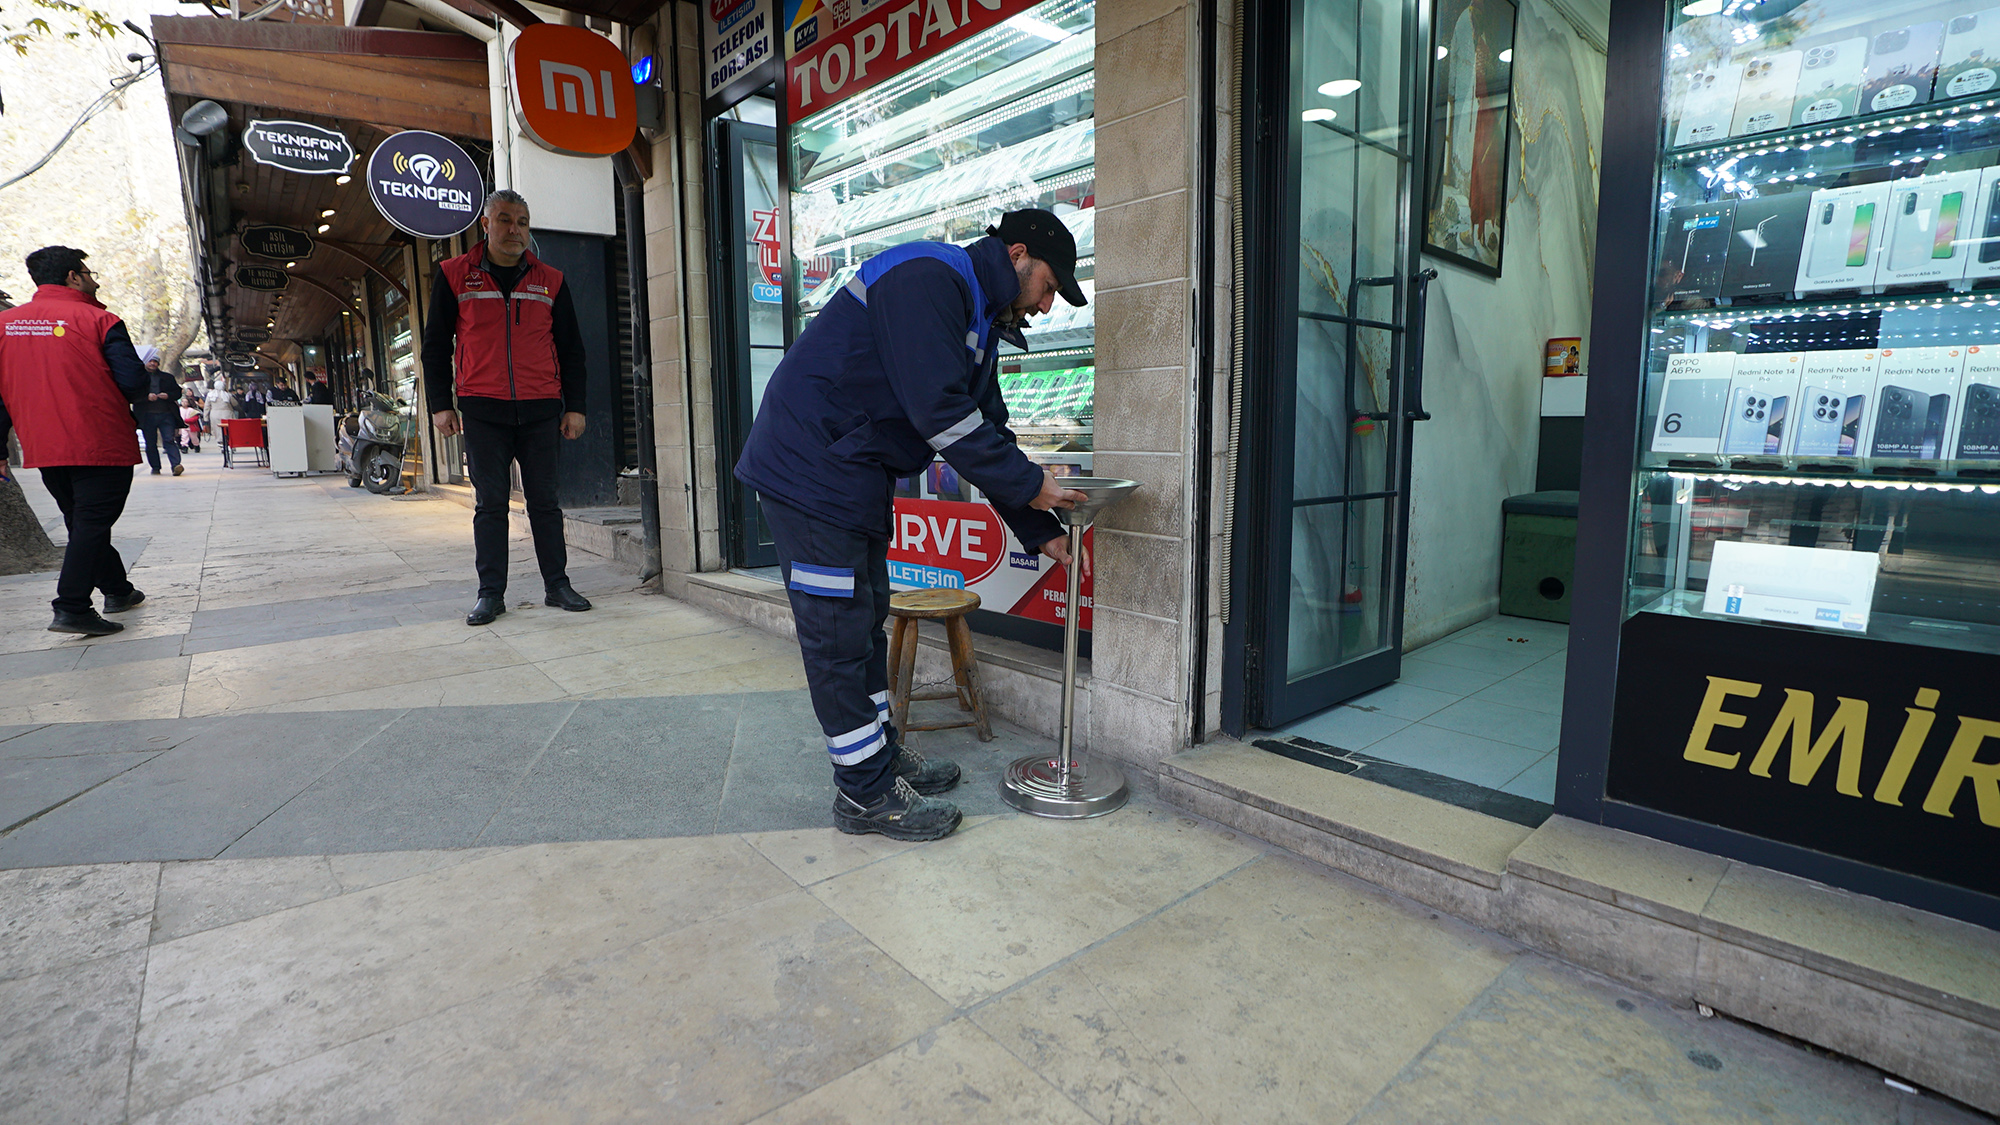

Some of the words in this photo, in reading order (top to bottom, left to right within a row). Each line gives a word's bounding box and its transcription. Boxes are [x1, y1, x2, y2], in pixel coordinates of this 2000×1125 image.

[712, 12, 764, 64] TELEFON
[797, 20, 816, 42] KVK
[711, 35, 768, 89] BORSASI
[256, 130, 342, 152] TEKNOFON
[272, 144, 329, 161] İLETİŞİM
[379, 180, 472, 204] TEKNOFON
[1663, 413, 1682, 434] 6
[1011, 557, 1037, 568] BAŞARI
[888, 562, 958, 589] İLETİŞİM
[1817, 611, 1839, 619] KVK
